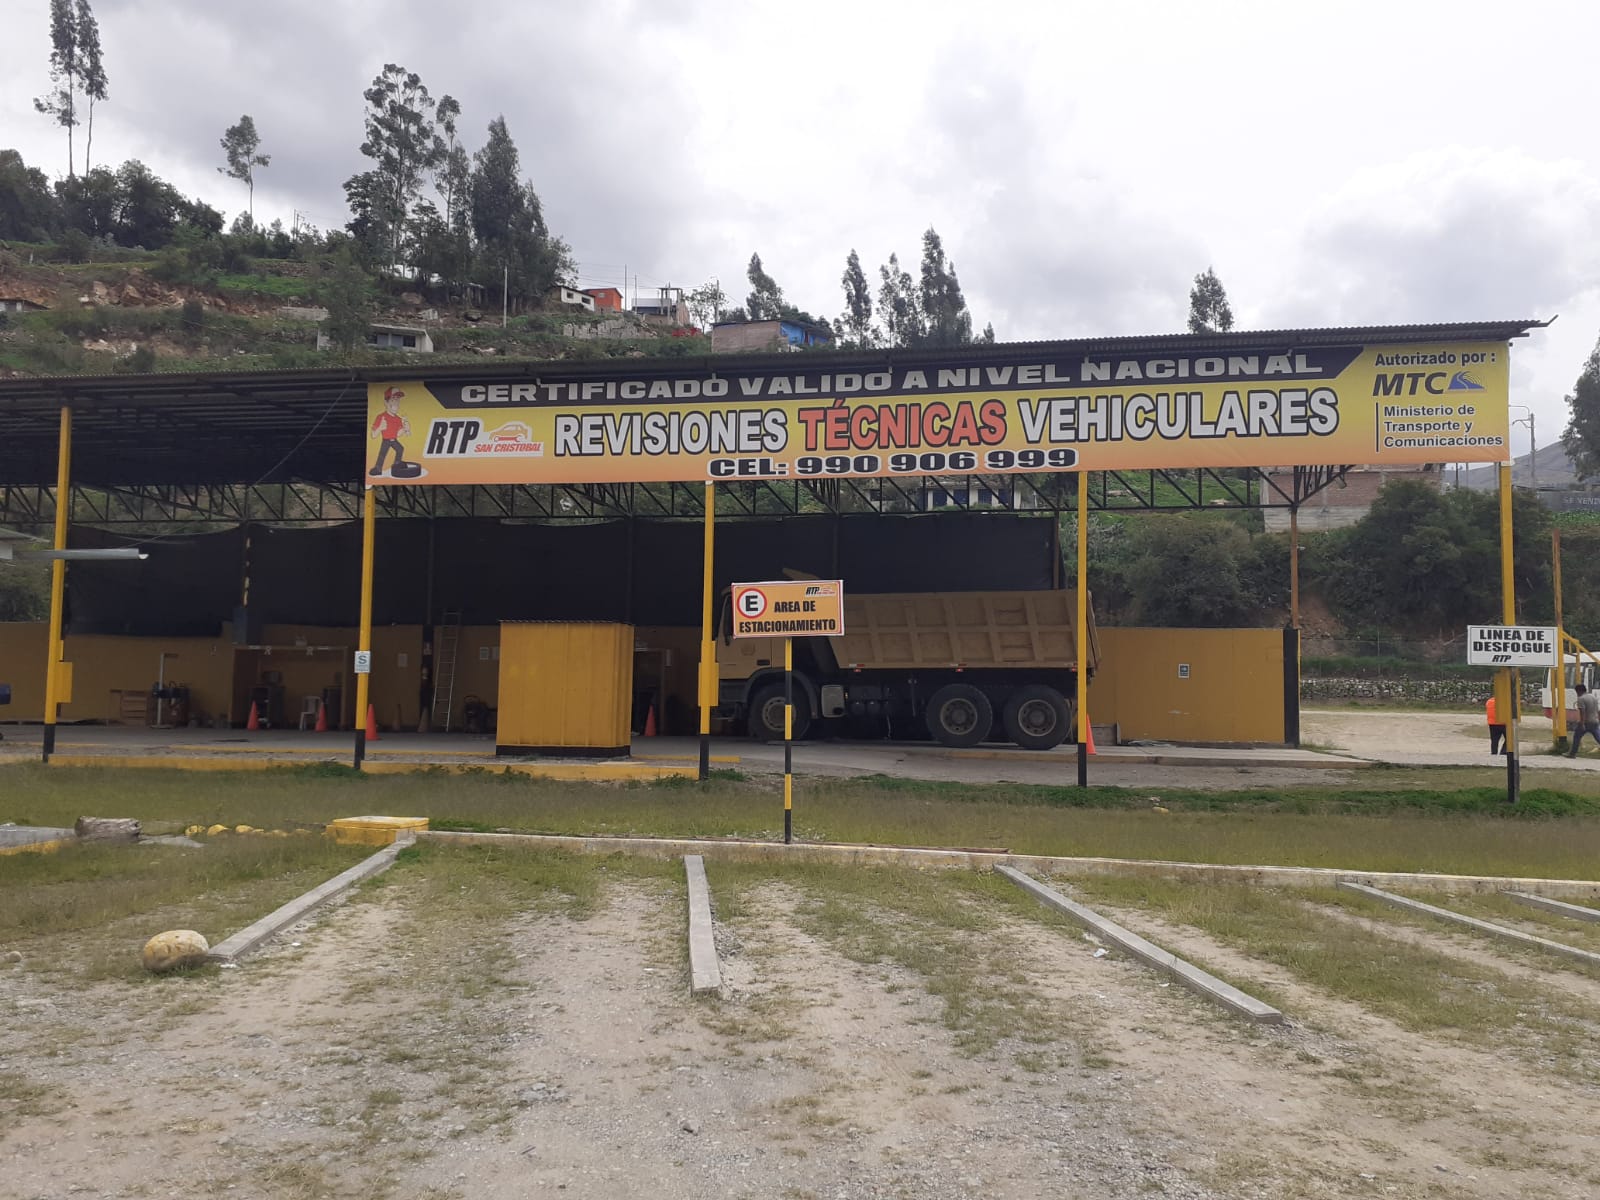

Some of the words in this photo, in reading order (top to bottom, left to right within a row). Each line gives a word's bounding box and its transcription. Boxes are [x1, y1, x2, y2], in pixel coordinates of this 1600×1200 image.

[1375, 352, 1457, 366] Autorizado
[1461, 352, 1486, 366] por
[461, 378, 729, 403] CERTIFICADO
[740, 372, 892, 395] VALIDO
[902, 370, 928, 389] A
[937, 364, 1070, 388] NIVEL
[1080, 354, 1323, 382] NACIONAL
[1373, 372, 1447, 396] MTC
[1384, 405, 1453, 416] Ministerio
[1457, 405, 1475, 415] de
[555, 409, 787, 456] REVISIONES
[798, 398, 1006, 450] TÉCNICAS
[1017, 387, 1340, 442] VEHICULARES
[1384, 421, 1460, 434] Transporte
[1465, 422, 1472, 433] y
[427, 420, 480, 454] RTP
[1384, 436, 1503, 447] Comunicaciones
[474, 444, 492, 453] SAN
[494, 443, 541, 453] CRISTOBAL
[709, 458, 789, 476] CEL:
[796, 455, 887, 474] 990
[889, 452, 977, 472] 906
[985, 449, 1077, 469] 999
[806, 587, 819, 595] RTP
[745, 595, 758, 612] E
[774, 601, 800, 613] AREA
[803, 600, 816, 612] DE
[739, 619, 836, 633] ESTACIONAMIENTO
[1480, 629, 1522, 640] LINEA
[1526, 630, 1544, 641] DE
[1473, 641, 1552, 653] DESFOGUE
[358, 655, 367, 664] S
